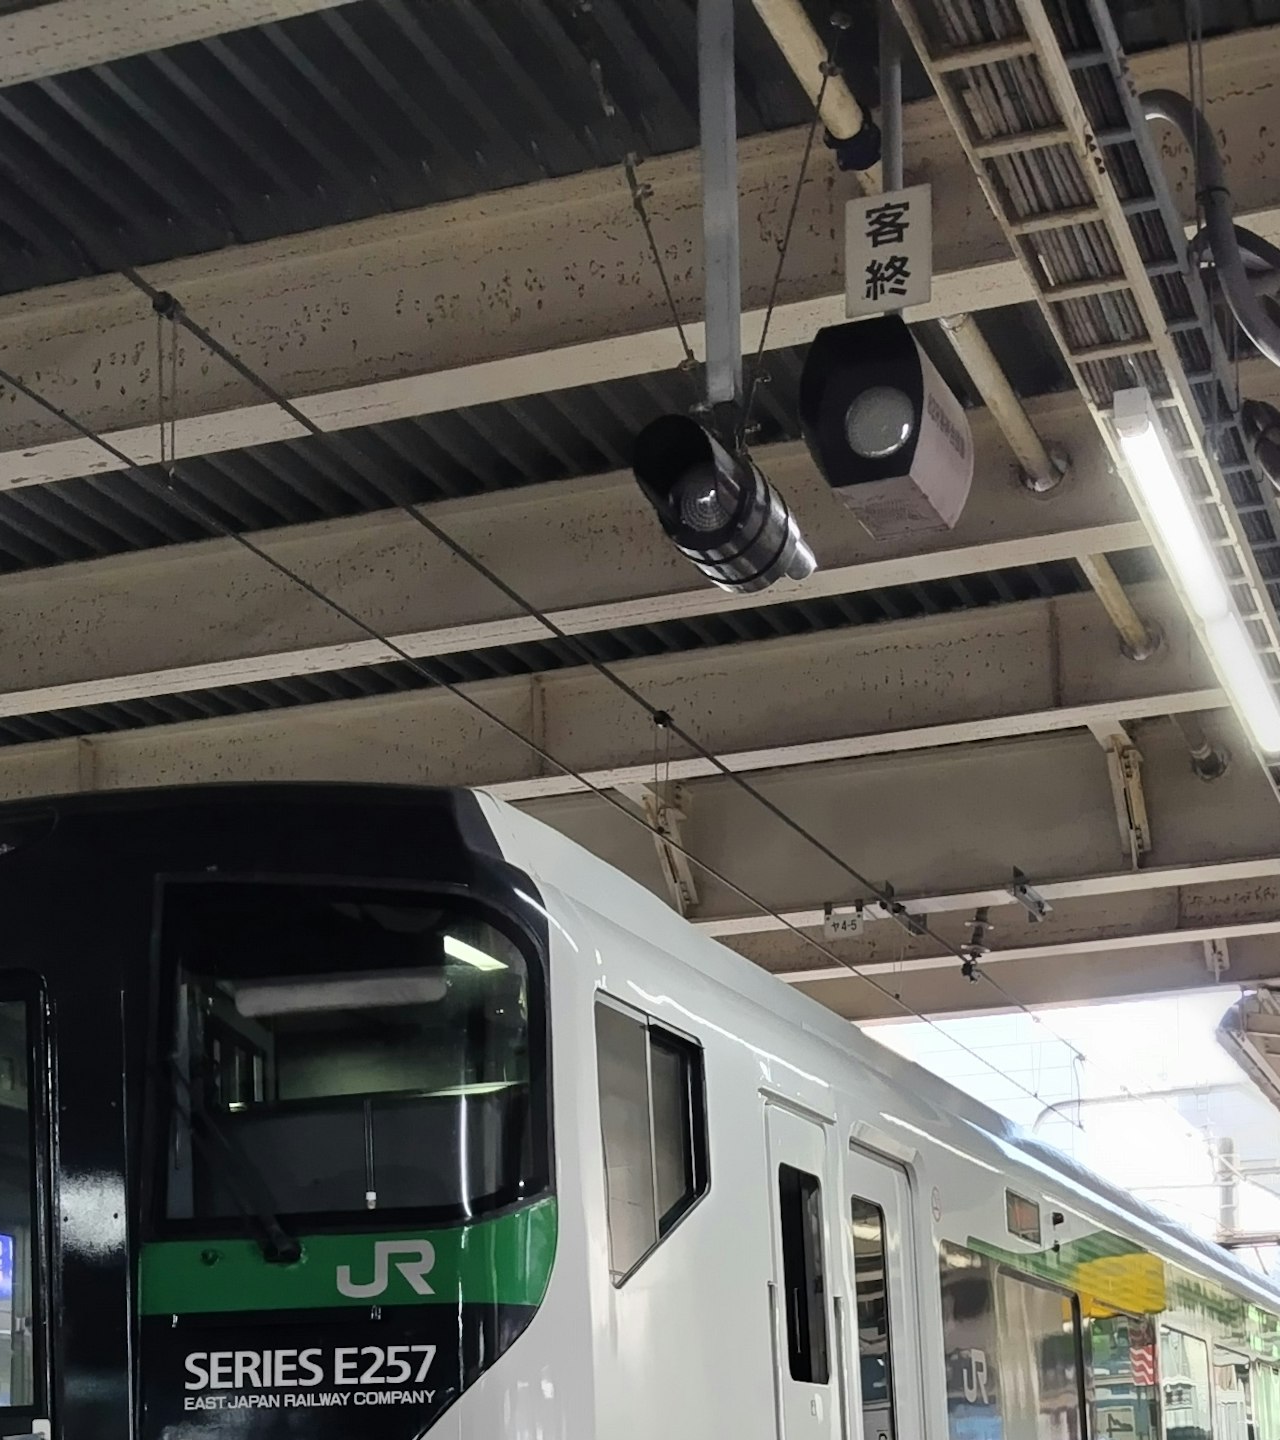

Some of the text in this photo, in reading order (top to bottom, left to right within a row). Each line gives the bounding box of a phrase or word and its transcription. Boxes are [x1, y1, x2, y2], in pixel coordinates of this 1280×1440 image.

[865, 202, 911, 301] 客終
[336, 1239, 435, 1298] JR
[184, 1345, 436, 1390] SERIES E257
[962, 1348, 989, 1404] JR
[184, 1390, 436, 1410] EAST JAPAN RAILWAY COMPANY
